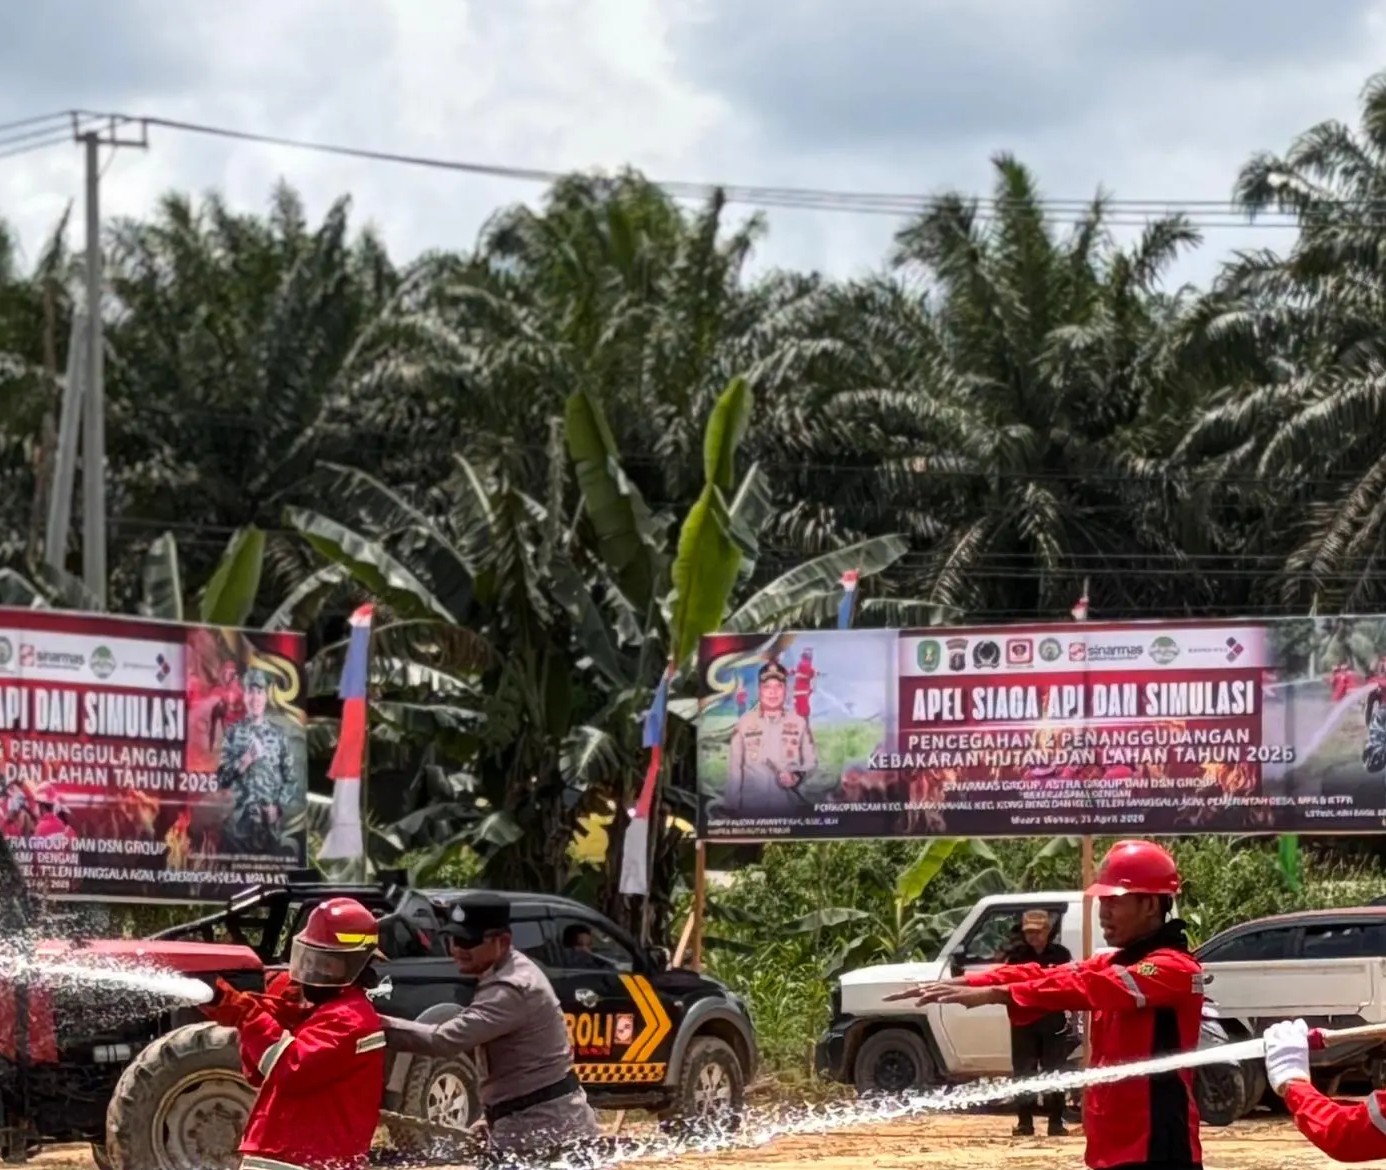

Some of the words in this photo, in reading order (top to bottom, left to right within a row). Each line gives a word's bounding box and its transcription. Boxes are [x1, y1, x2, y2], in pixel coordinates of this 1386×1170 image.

[1088, 645, 1144, 656] sinarmas
[912, 687, 964, 721] APEL
[972, 684, 1039, 721] SIAGA
[1047, 683, 1084, 720] API
[1092, 682, 1138, 718] DAN
[1145, 679, 1255, 717] SIMULASI
[35, 688, 78, 734] DAN
[84, 691, 184, 741] SIMULASI
[908, 732, 1036, 750] PENCEGAHAN
[1061, 728, 1250, 748] PENANGGULANGAN
[9, 740, 182, 769] PENANGGULANGAN
[867, 751, 979, 769] KEBAKARAN
[984, 749, 1049, 767] HUTAN
[1056, 748, 1095, 765] DAN
[1102, 747, 1168, 765] LAHAN
[1174, 745, 1241, 763] TAHUN
[1245, 745, 1294, 763] 2026
[48, 765, 108, 787] LAHAN
[114, 769, 175, 791] TAHUN
[179, 773, 218, 793] 2026
[564, 1012, 613, 1049] ROLI
